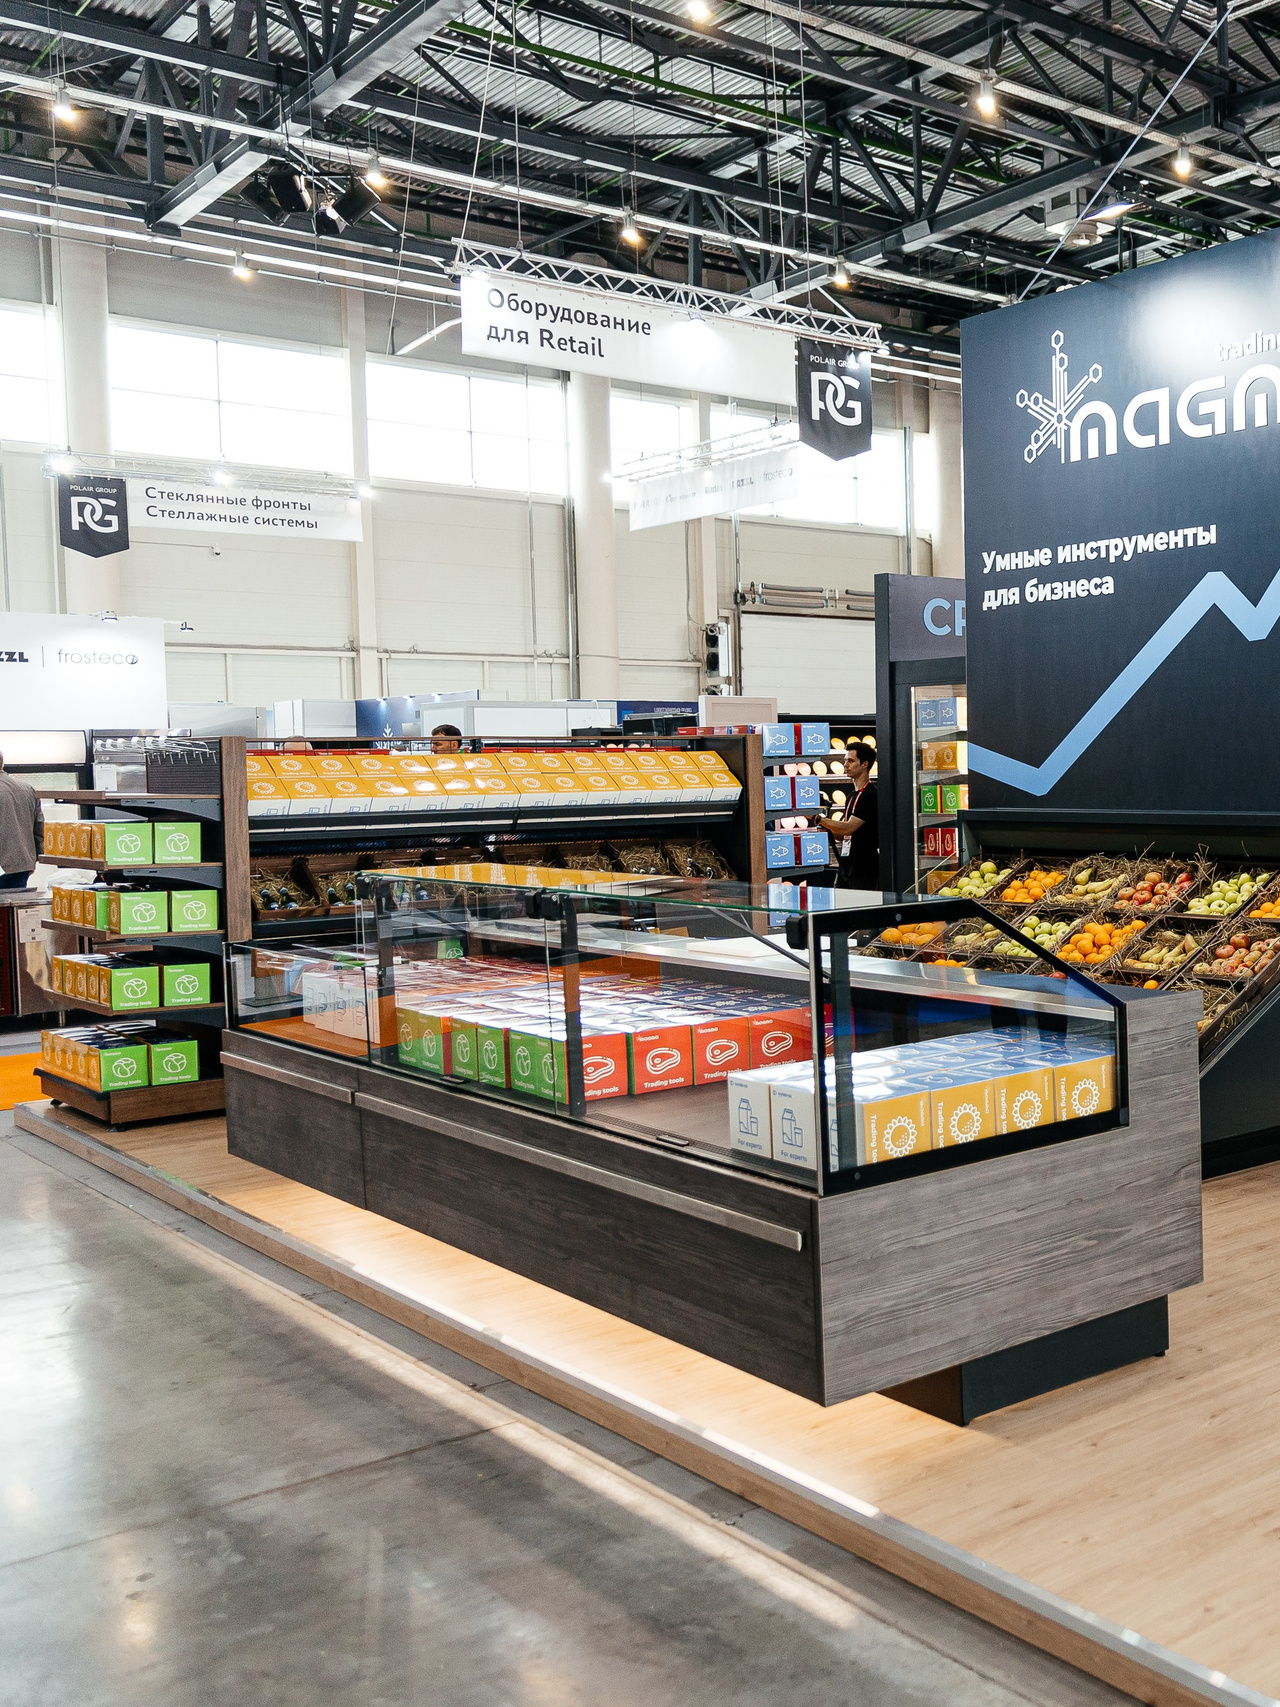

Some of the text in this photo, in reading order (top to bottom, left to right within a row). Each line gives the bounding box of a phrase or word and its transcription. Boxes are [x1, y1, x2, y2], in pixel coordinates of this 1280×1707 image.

[487, 288, 651, 335] Оборудование
[487, 324, 605, 357] для Retail
[810, 355, 836, 366] POLAIR
[70, 484, 94, 492] POLAIR
[145, 486, 311, 511] Стеклянные фронты
[146, 505, 318, 529] Стеллажные системы
[981, 524, 1217, 574] Умные инструменты
[982, 575, 1115, 611] для бизнеса
[703, 1070, 727, 1080] Trading
[644, 1077, 685, 1089] Trading tools
[603, 1086, 619, 1094] tools
[745, 1140, 763, 1151] experts
[789, 1152, 807, 1162] experts
